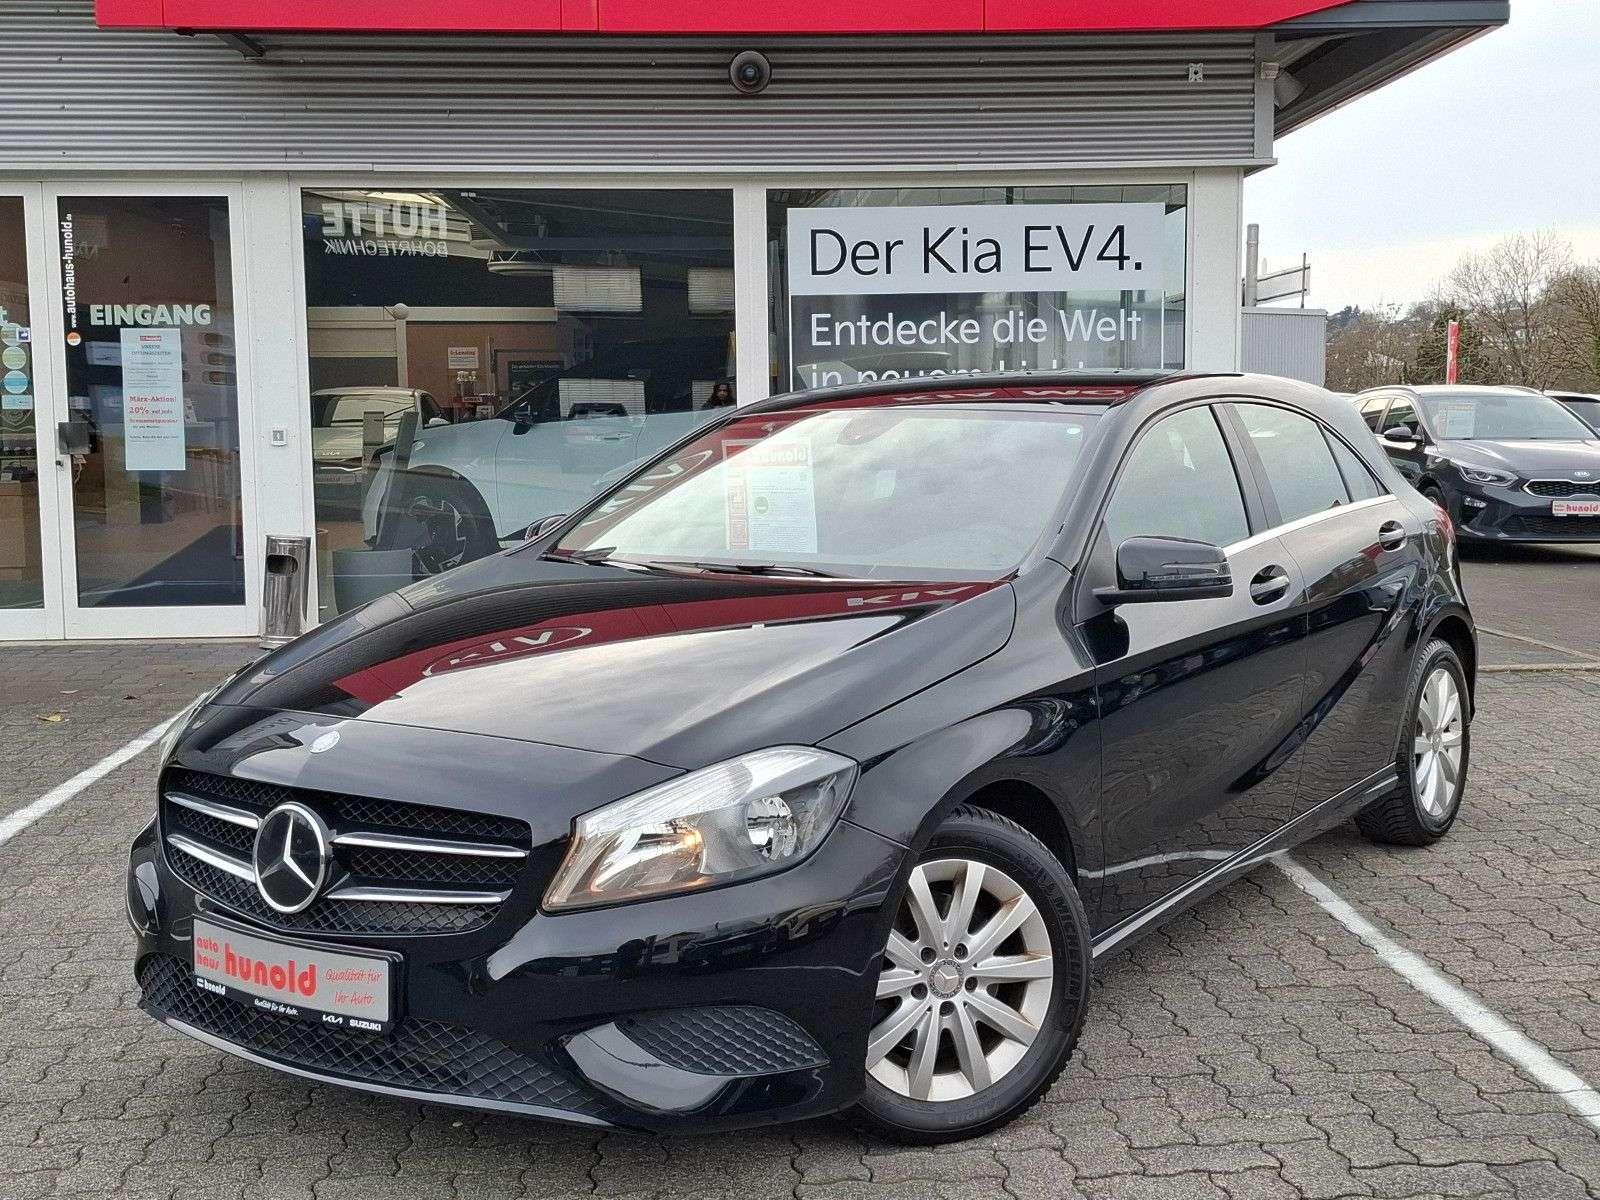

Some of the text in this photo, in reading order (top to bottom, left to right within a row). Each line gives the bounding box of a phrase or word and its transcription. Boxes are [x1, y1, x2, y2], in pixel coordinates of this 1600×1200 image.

[809, 224, 1143, 276] Der Kia EV4.
[90, 304, 211, 326] EINGANG
[810, 309, 1142, 346] Entdecke die Welt
[196, 936, 219, 952] auto
[224, 942, 318, 998] hunold
[197, 950, 220, 970] haus
[349, 1019, 382, 1032] SUZUKI
